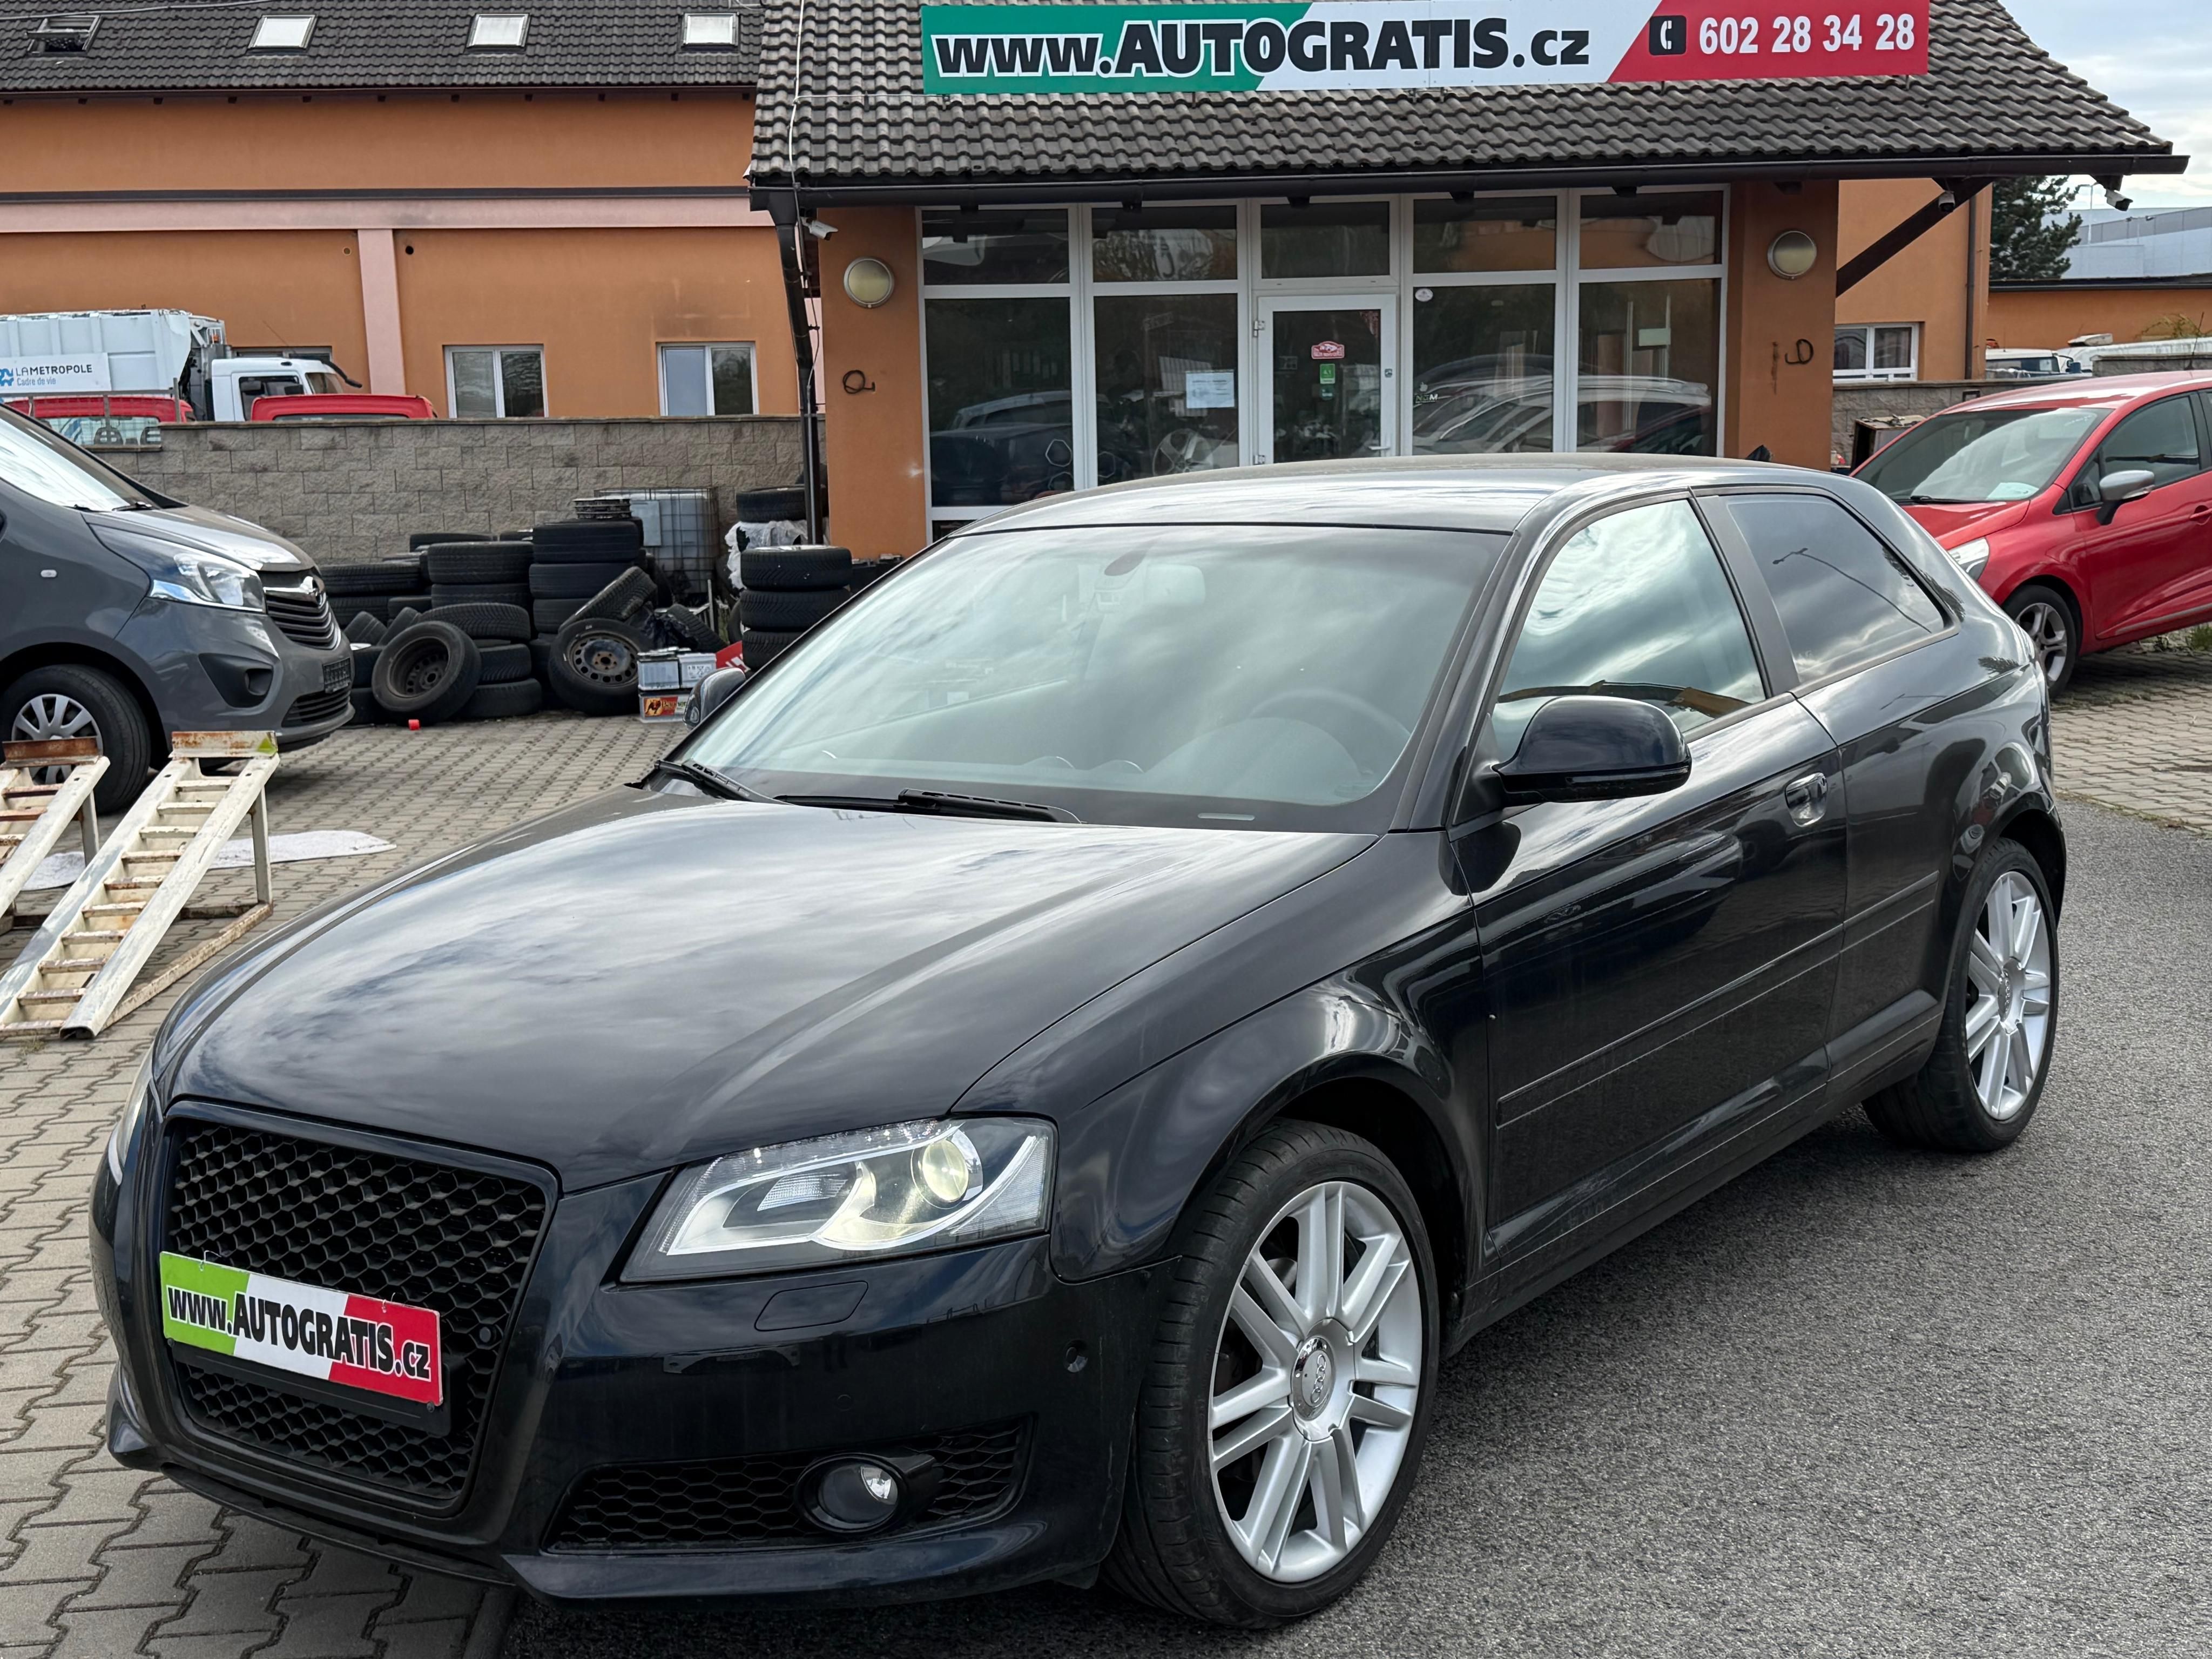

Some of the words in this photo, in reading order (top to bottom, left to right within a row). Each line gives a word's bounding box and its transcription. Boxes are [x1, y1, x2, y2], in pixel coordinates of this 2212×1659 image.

[932, 17, 1590, 77] www.AUTOGRATIS.cz
[1699, 16, 1759, 55] 602
[1772, 15, 1811, 53] 28
[1822, 14, 1863, 52] 34
[1875, 13, 1915, 51] 28
[17, 377, 36, 386] Cadre
[46, 376, 56, 385] vie
[166, 1286, 431, 1381] www.AUTOGRATIS.cz
